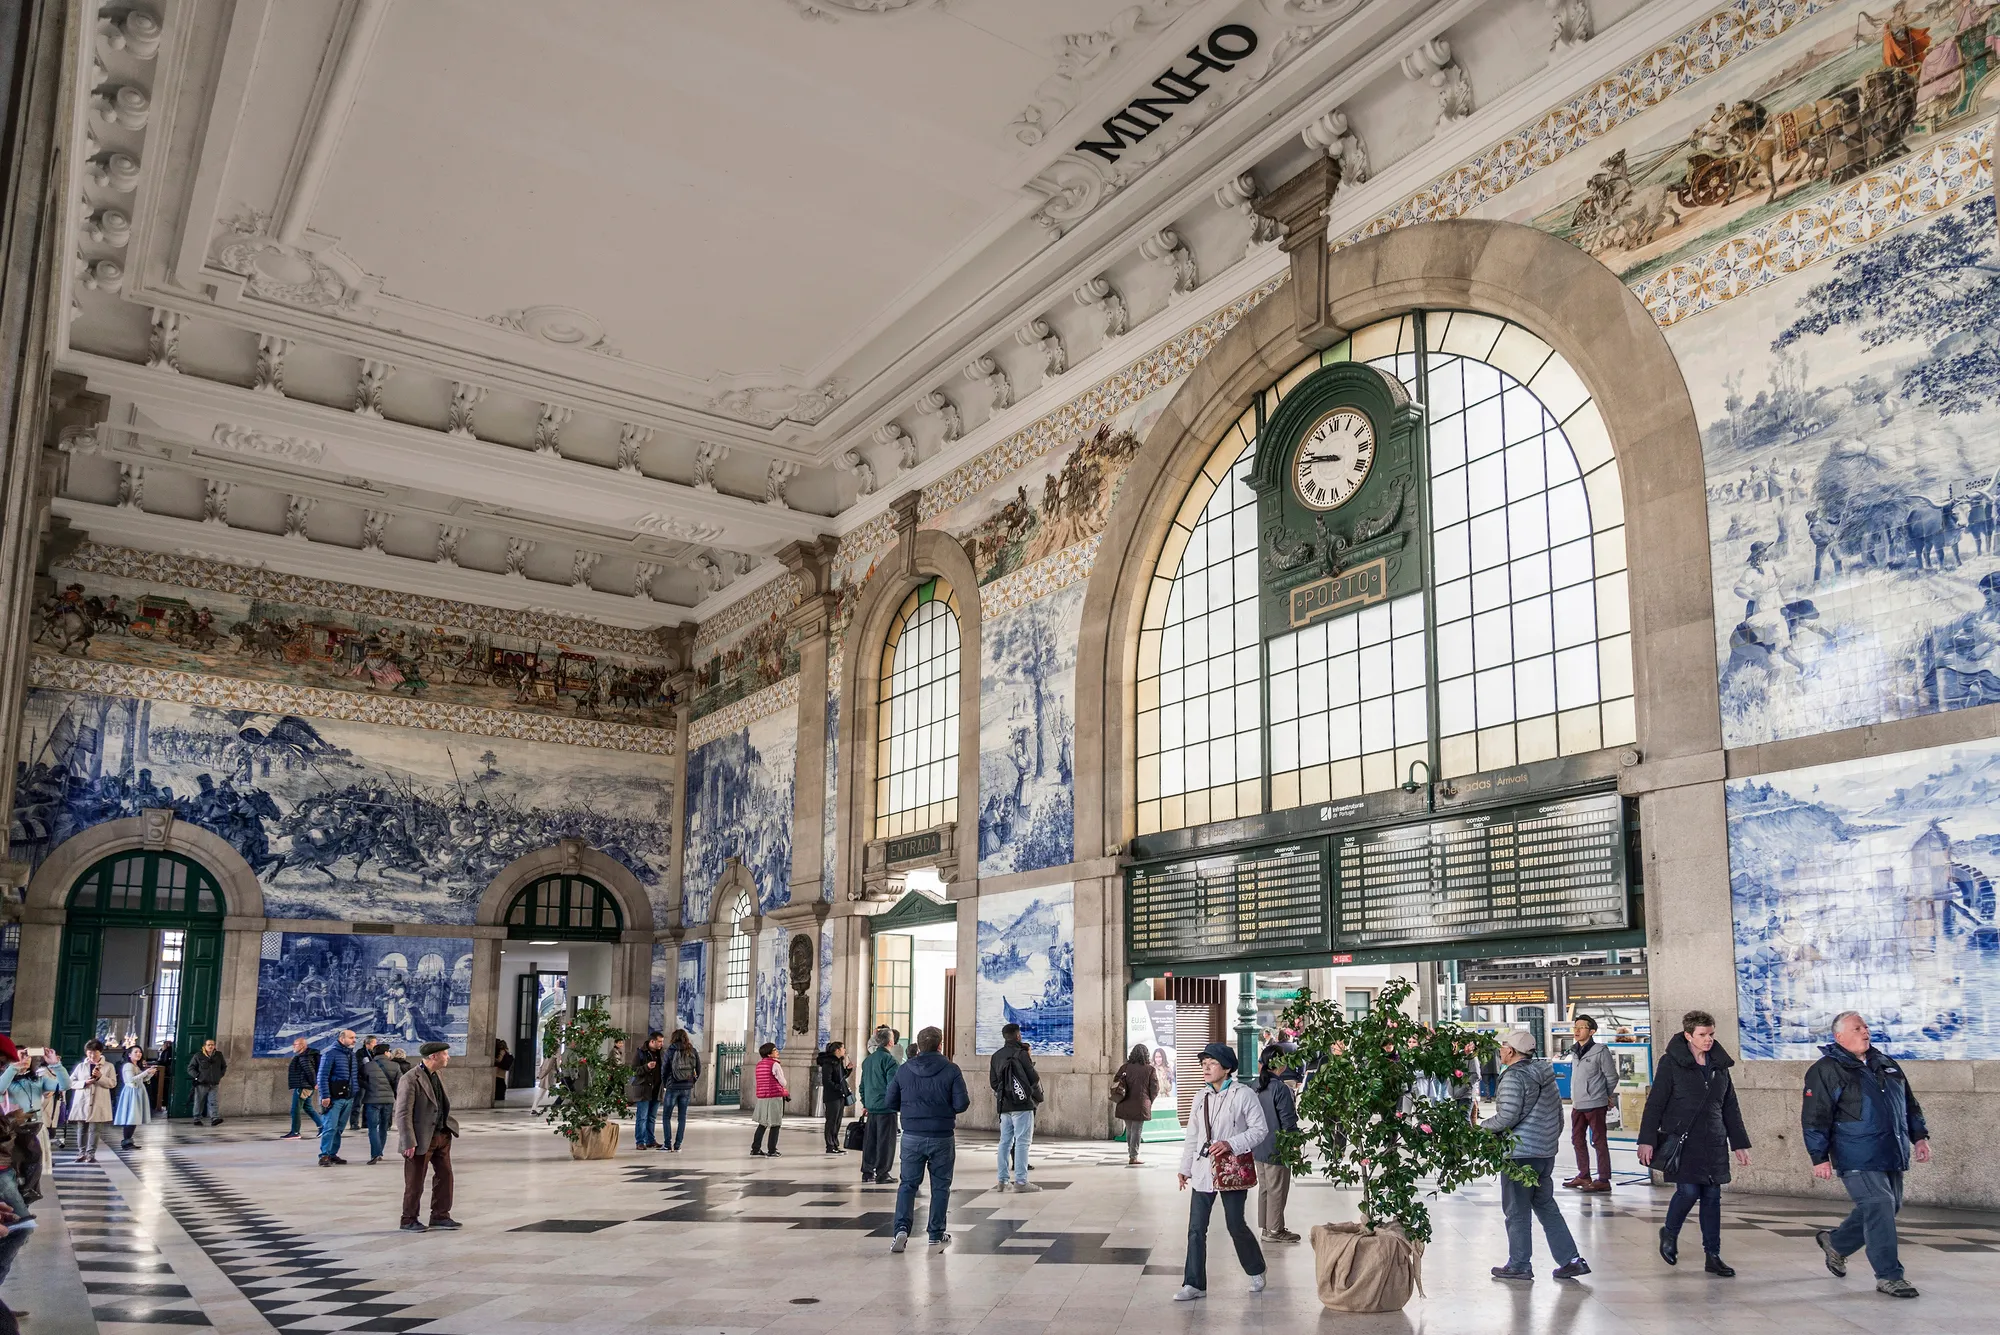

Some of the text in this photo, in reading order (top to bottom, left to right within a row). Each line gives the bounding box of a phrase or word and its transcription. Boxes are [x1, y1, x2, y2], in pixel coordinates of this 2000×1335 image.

[1075, 24, 1258, 164] MINHO
[1329, 420, 1339, 434] XII
[1345, 418, 1352, 431] I
[1315, 429, 1326, 444] XI
[1354, 426, 1365, 438] II
[1358, 440, 1369, 453] III
[1305, 478, 1316, 495] VIII
[1346, 479, 1354, 489] V
[1315, 487, 1326, 501] VII
[1330, 487, 1338, 499] VI
[1304, 571, 1369, 612] PORTO
[1496, 772, 1528, 787] Arrivals
[1333, 802, 1364, 813] Infraestruturas
[1339, 809, 1355, 817] Portugal
[1466, 816, 1490, 824] comboio
[891, 836, 936, 859] ENTRADA
[1491, 860, 1514, 871] 15156
[1239, 893, 1255, 901] 15722
[1521, 891, 1565, 903] SUPRIMIDO
[1239, 902, 1255, 911] 15157
[1239, 912, 1255, 920] 15217
